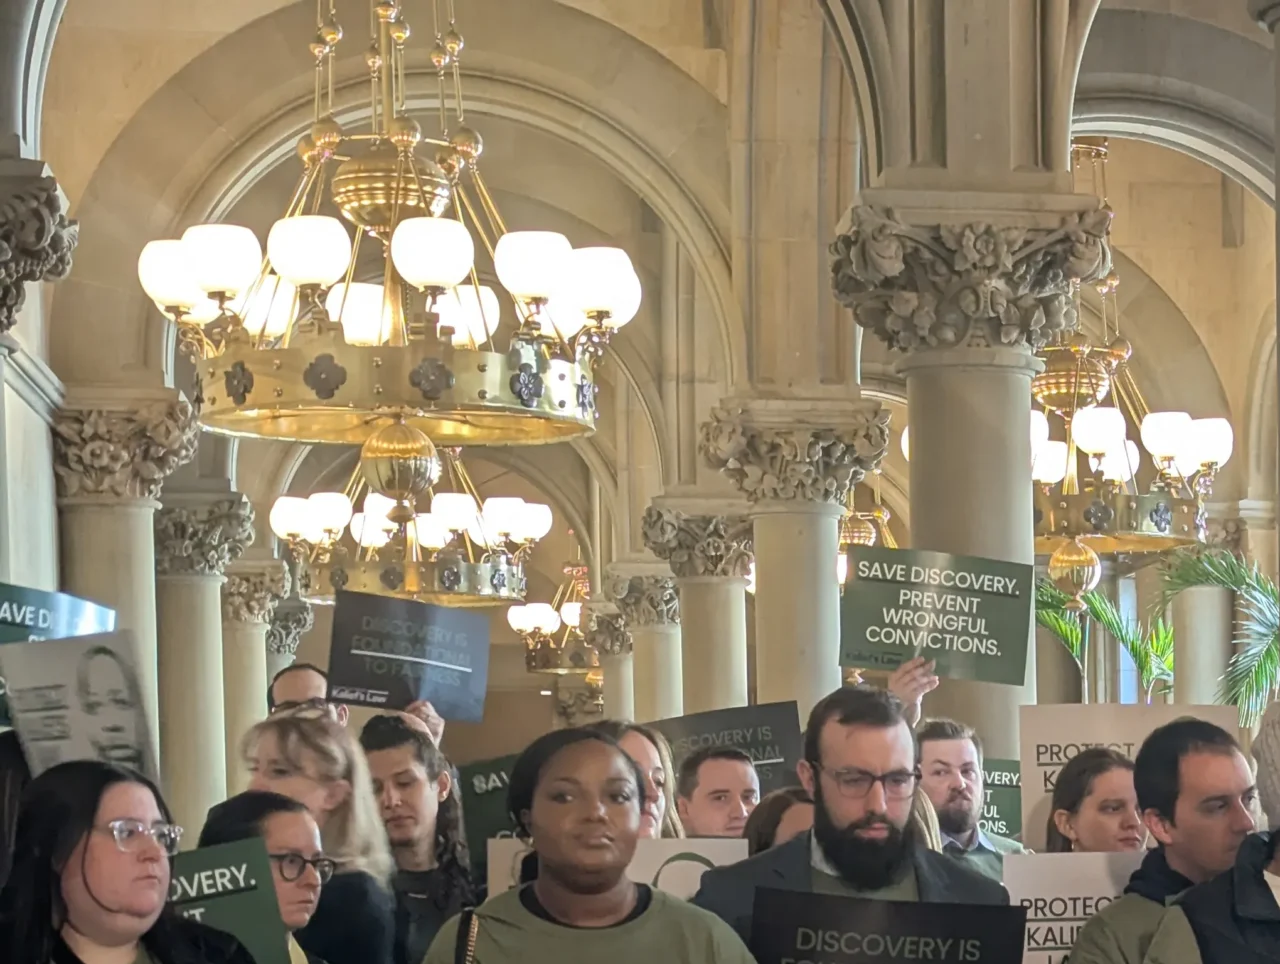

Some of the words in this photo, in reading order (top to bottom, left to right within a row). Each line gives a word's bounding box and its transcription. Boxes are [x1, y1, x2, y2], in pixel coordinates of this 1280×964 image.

[858, 561, 906, 581] SAVE
[911, 566, 1020, 595] DISCOVERY.
[0, 602, 35, 625] AVE
[899, 589, 981, 614] PREVENT
[882, 608, 989, 635] WRONGFUL
[866, 626, 1002, 656] CONVICTIONS.
[757, 726, 772, 741] IS
[1020, 896, 1121, 917] PROTEC
[796, 927, 953, 960] DISCOVERY
[958, 939, 981, 961] IS
